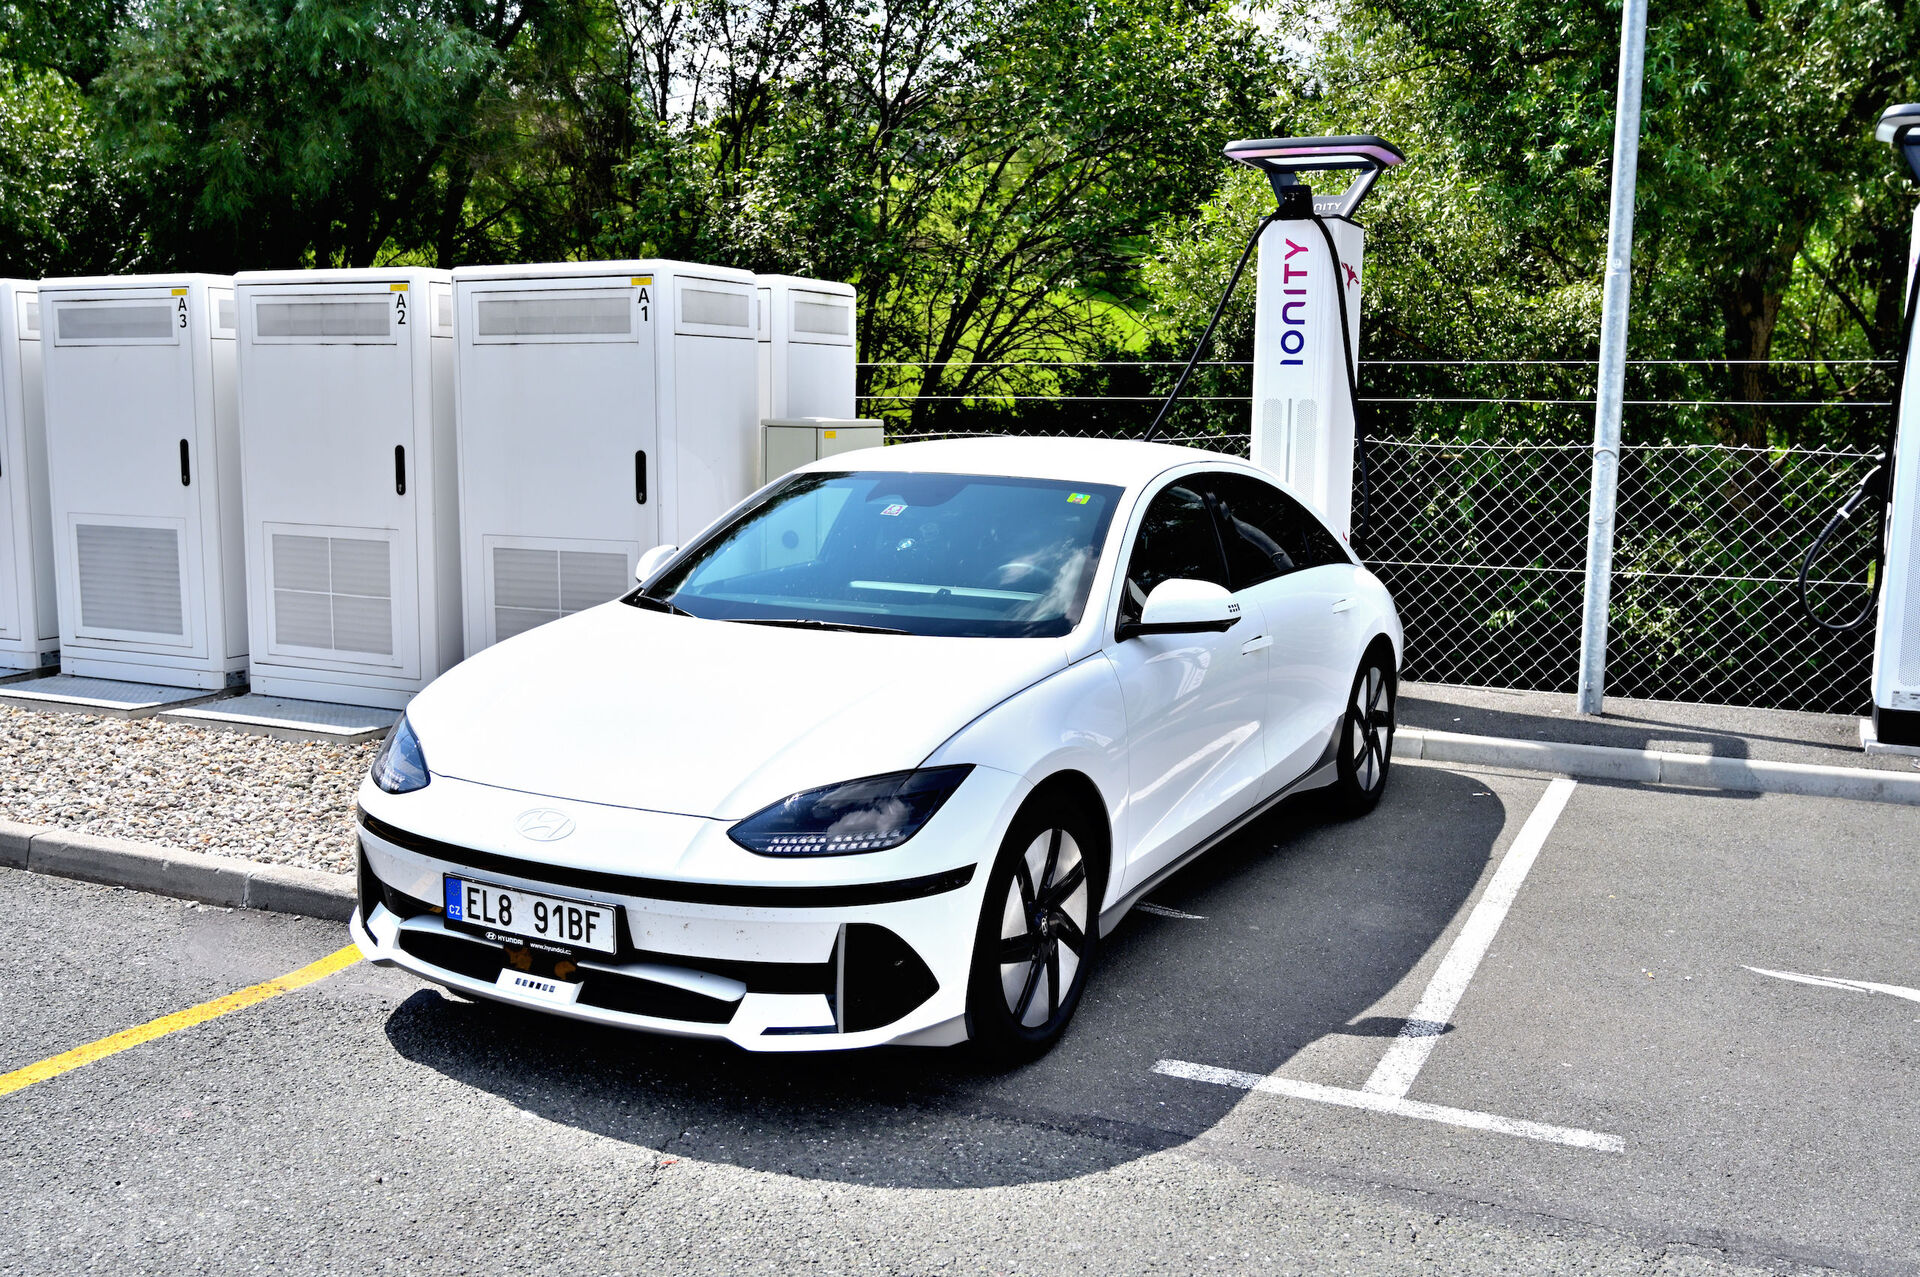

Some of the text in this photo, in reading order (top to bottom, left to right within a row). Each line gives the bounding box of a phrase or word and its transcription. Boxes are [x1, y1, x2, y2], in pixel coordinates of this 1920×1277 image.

[396, 293, 407, 309] A
[638, 287, 650, 304] A
[1280, 238, 1309, 366] IONITY
[178, 297, 188, 312] A
[179, 313, 187, 329] 3
[397, 309, 406, 325] 2
[641, 305, 648, 322] 1
[449, 904, 461, 916] CZ
[467, 886, 600, 943] EL8 91BF
[497, 934, 524, 945] HYUNDAI
